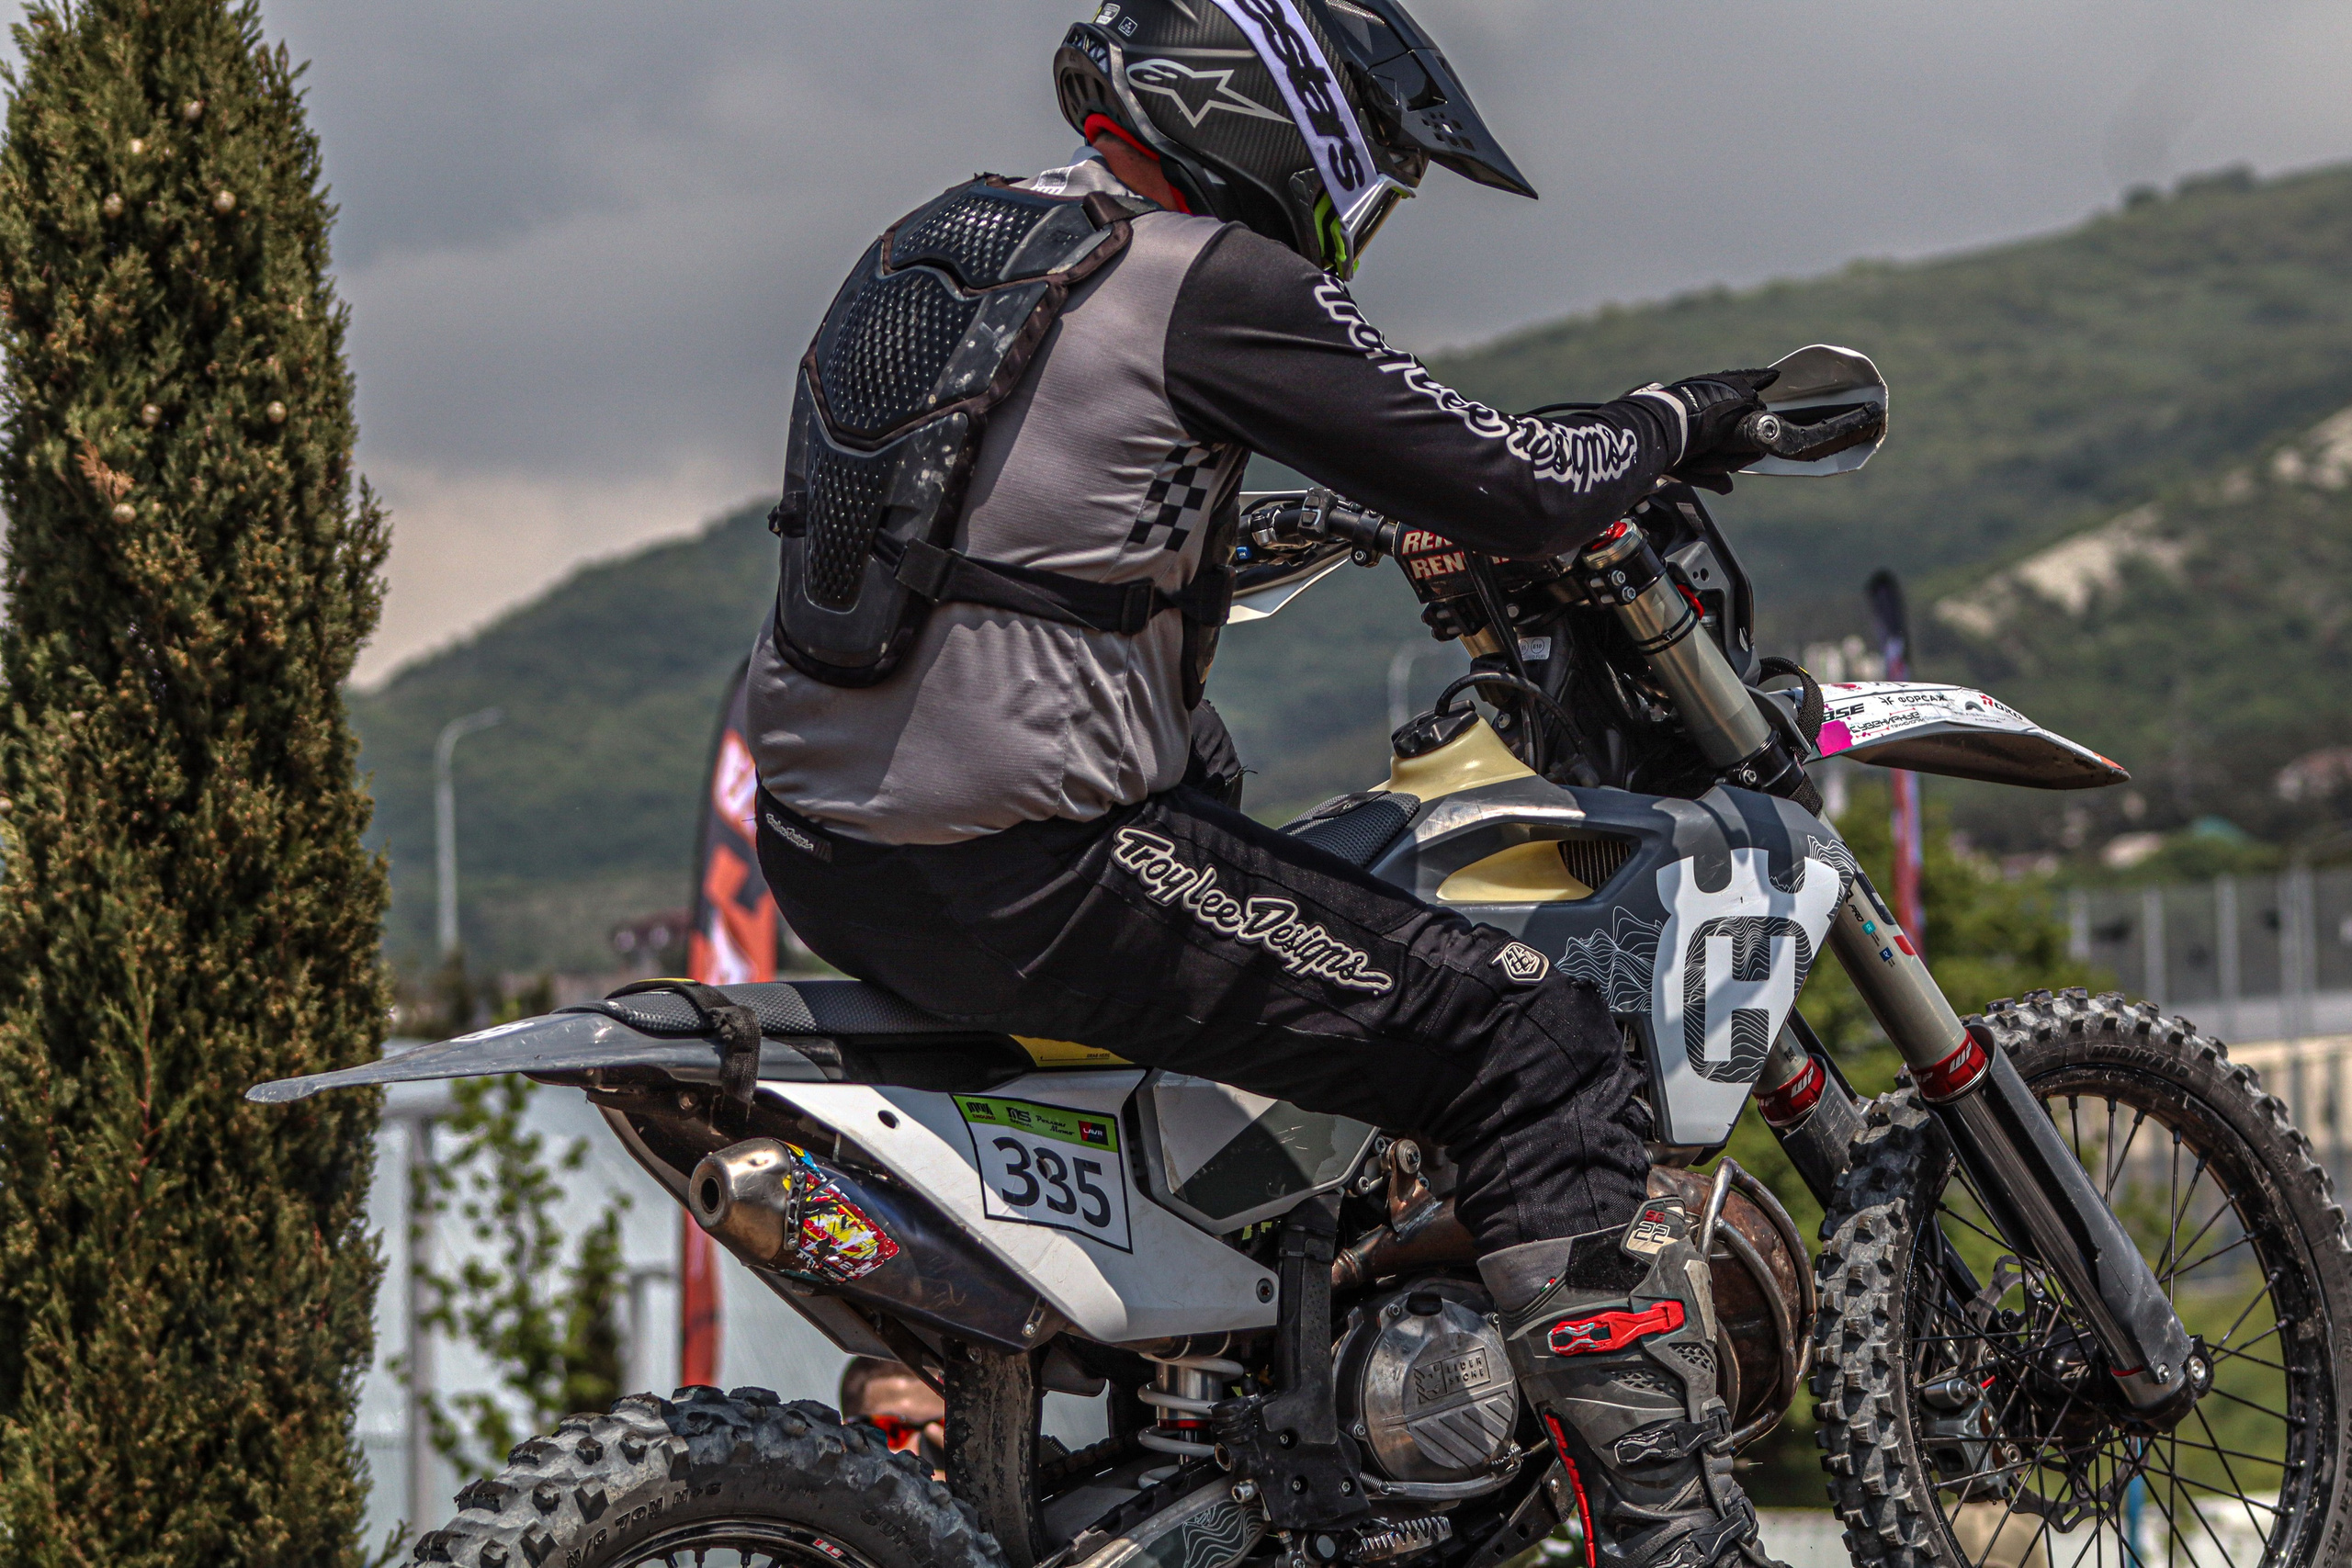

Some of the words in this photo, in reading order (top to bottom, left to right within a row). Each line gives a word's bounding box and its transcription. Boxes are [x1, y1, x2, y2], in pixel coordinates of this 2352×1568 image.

[1898, 694, 1947, 704] ФОРСАЖ
[1112, 827, 1196, 907] Troy
[1180, 863, 1245, 934] Lee
[1235, 896, 1395, 993] Designs
[1849, 904, 1864, 922] PRO
[1949, 1041, 1973, 1074] WP
[1082, 1127, 1103, 1136] LAVR
[992, 1136, 1111, 1228] 335
